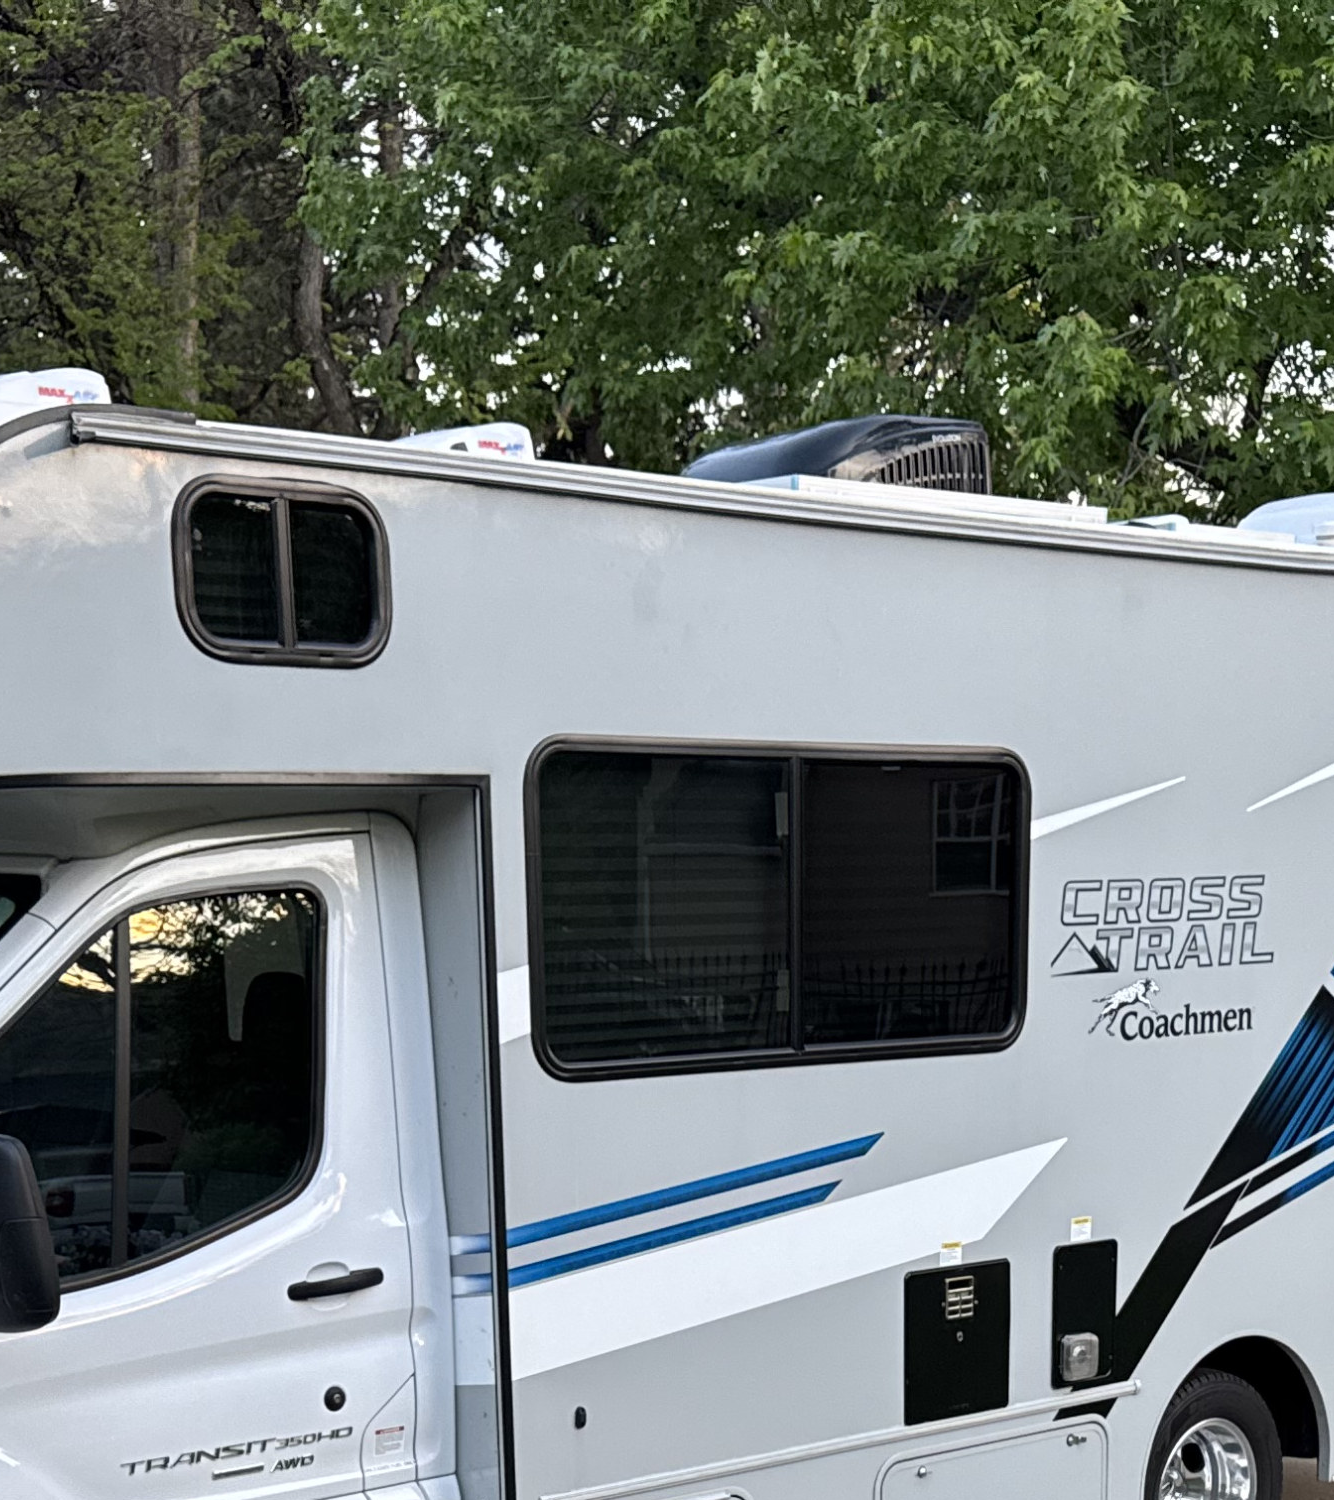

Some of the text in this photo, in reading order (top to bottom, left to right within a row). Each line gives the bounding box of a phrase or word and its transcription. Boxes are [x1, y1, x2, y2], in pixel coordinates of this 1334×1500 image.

[1060, 874, 1266, 926] CROSS
[1095, 921, 1274, 972] TRAIL
[1119, 1003, 1254, 1042] Coachmen
[120, 1437, 276, 1476] TRANSIT
[270, 1453, 315, 1473] AWD
